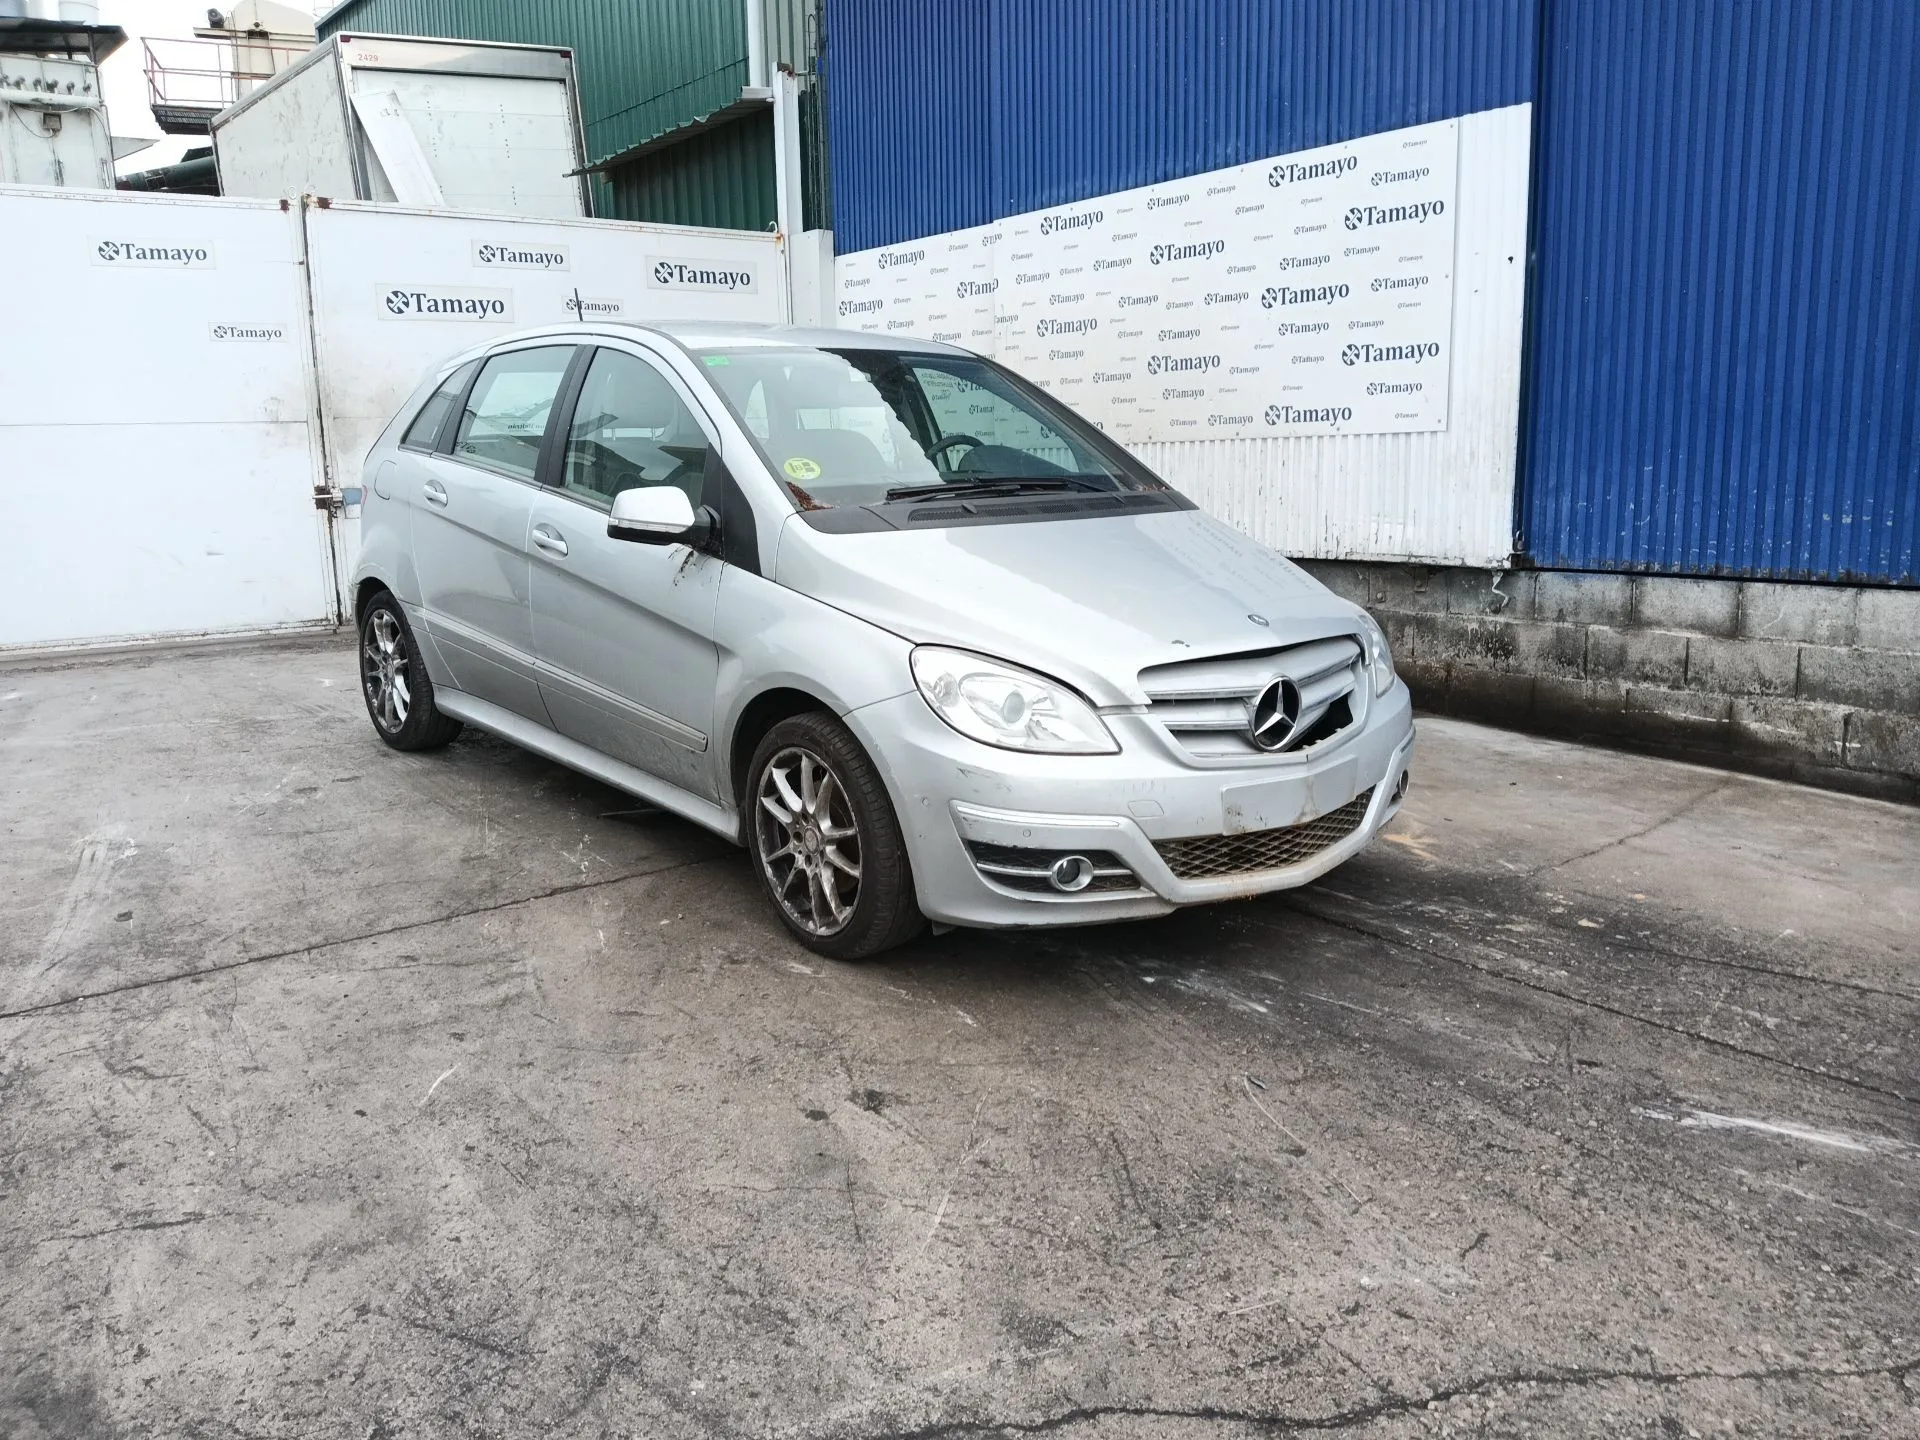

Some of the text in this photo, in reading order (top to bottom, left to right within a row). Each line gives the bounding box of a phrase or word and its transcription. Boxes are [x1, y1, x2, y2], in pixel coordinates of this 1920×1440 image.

[358, 54, 378, 62] 2429
[1286, 156, 1357, 182] Tamayo
[1382, 168, 1429, 183] Tamayo
[1213, 185, 1235, 195] Tamayo
[1156, 195, 1189, 207] Tamayo
[1364, 201, 1444, 225] Tamayo
[1053, 211, 1103, 231] Tamayo
[1301, 224, 1326, 234] Tamayo
[121, 244, 207, 265] Tamayo
[1165, 240, 1224, 261] Tamayo
[497, 248, 563, 268] Tamayo
[888, 250, 924, 266] Tamayo
[1100, 258, 1131, 269] Tamayo
[1290, 255, 1330, 268] Tamayo
[674, 265, 750, 290] Tamayo
[1023, 273, 1049, 283] Tamayo
[1382, 276, 1428, 289] Tamayo
[1055, 294, 1084, 304] Tamayo
[1126, 295, 1158, 305] Tamayo
[1213, 293, 1248, 303] Tamayo
[1278, 284, 1349, 306] Tamayo
[410, 293, 504, 319] Tamayo
[848, 300, 882, 314] Tamayo
[228, 327, 281, 340] Tamayo
[1049, 319, 1097, 335] Tamayo
[1288, 323, 1329, 334] Tamayo
[1167, 329, 1200, 340] Tamayo
[1056, 350, 1084, 360] Tamayo
[1361, 343, 1439, 364] Tamayo
[1162, 355, 1220, 373] Tamayo
[1101, 373, 1131, 383] Tamayo
[1171, 389, 1204, 400] Tamayo
[1378, 383, 1422, 395] Tamayo
[1217, 415, 1253, 426] Tamayo
[1282, 406, 1352, 426] Tamayo
